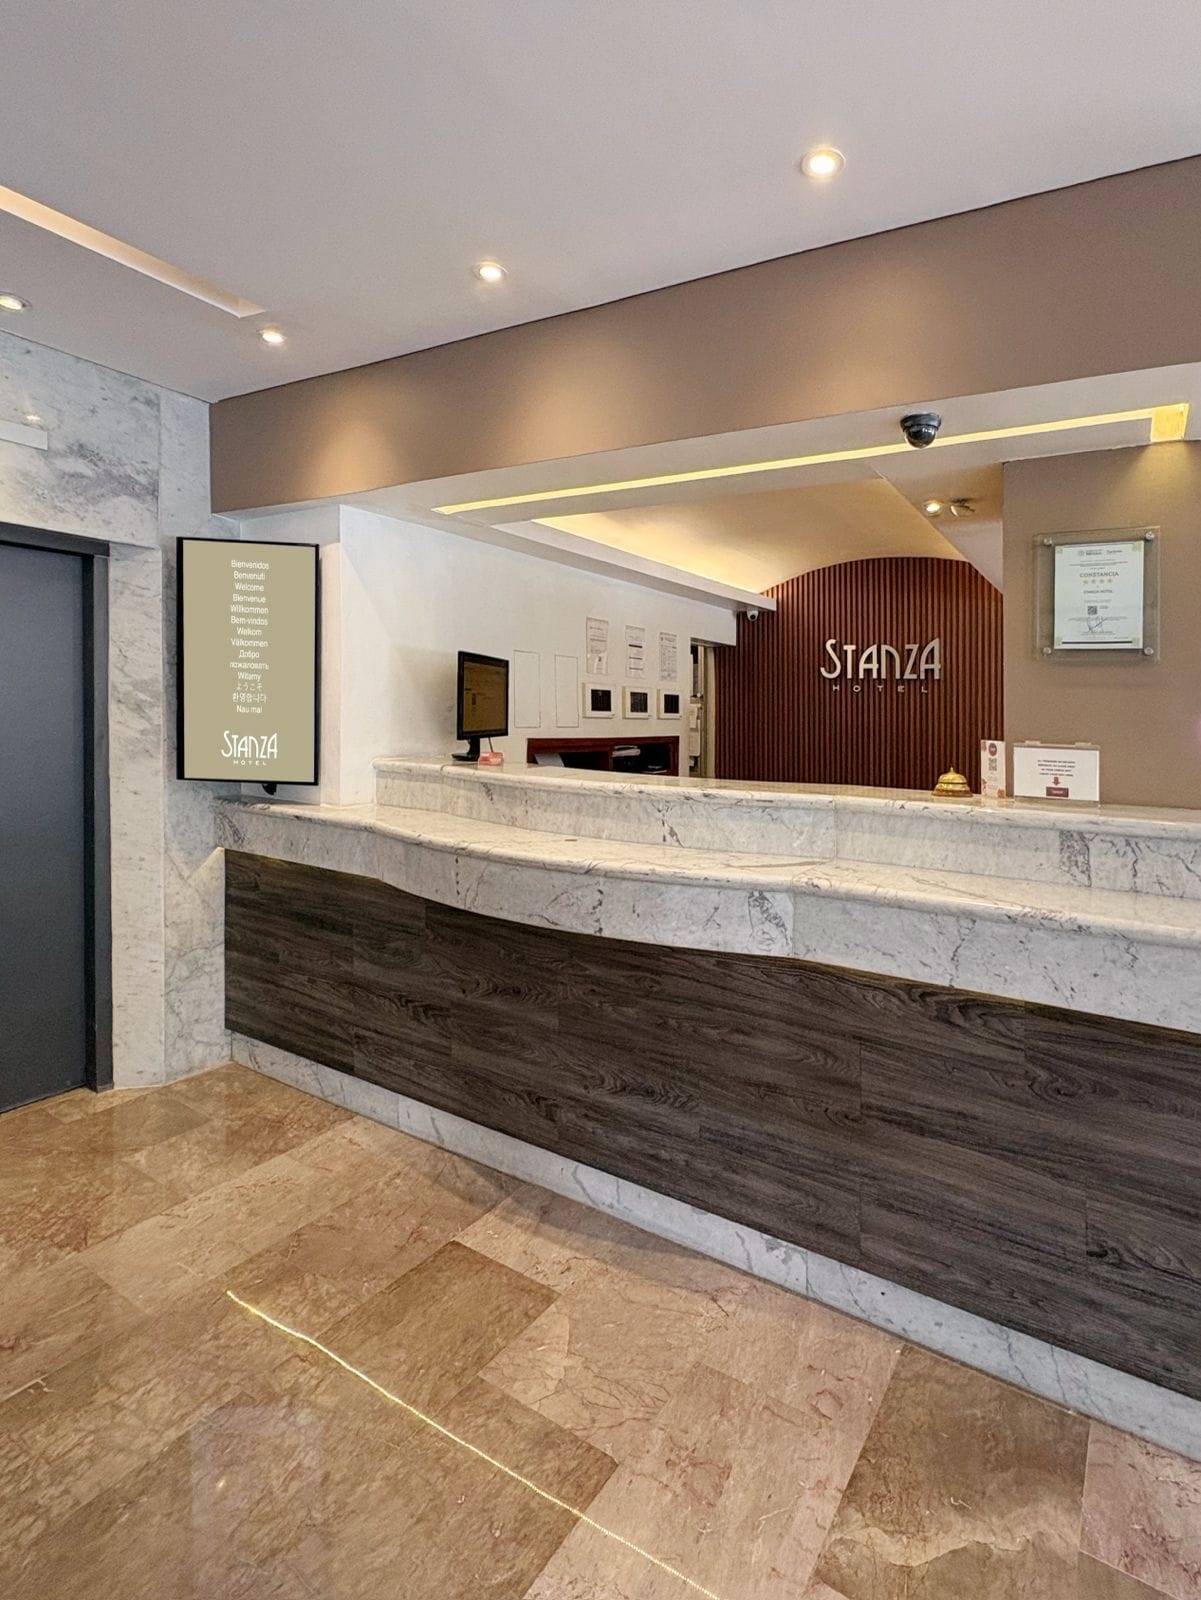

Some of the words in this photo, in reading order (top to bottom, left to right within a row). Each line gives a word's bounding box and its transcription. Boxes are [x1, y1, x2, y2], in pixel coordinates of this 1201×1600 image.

[231, 560, 269, 569] Bienvenidos
[234, 571, 265, 580] Benvenuti
[234, 582, 264, 591] Welcome
[232, 594, 266, 603] Bienvenue
[230, 604, 269, 614] Willkommen
[230, 616, 268, 625] Bem-vindos
[236, 627, 262, 636] Welkom
[230, 638, 269, 647] Välkommen
[239, 650, 259, 659] Добро
[820, 638, 941, 679] STANZA
[237, 672, 262, 682] Witamy
[832, 685, 928, 693] HOTEL
[236, 705, 250, 713] Nau
[251, 706, 263, 714] mai
[221, 730, 278, 759] STANZA
